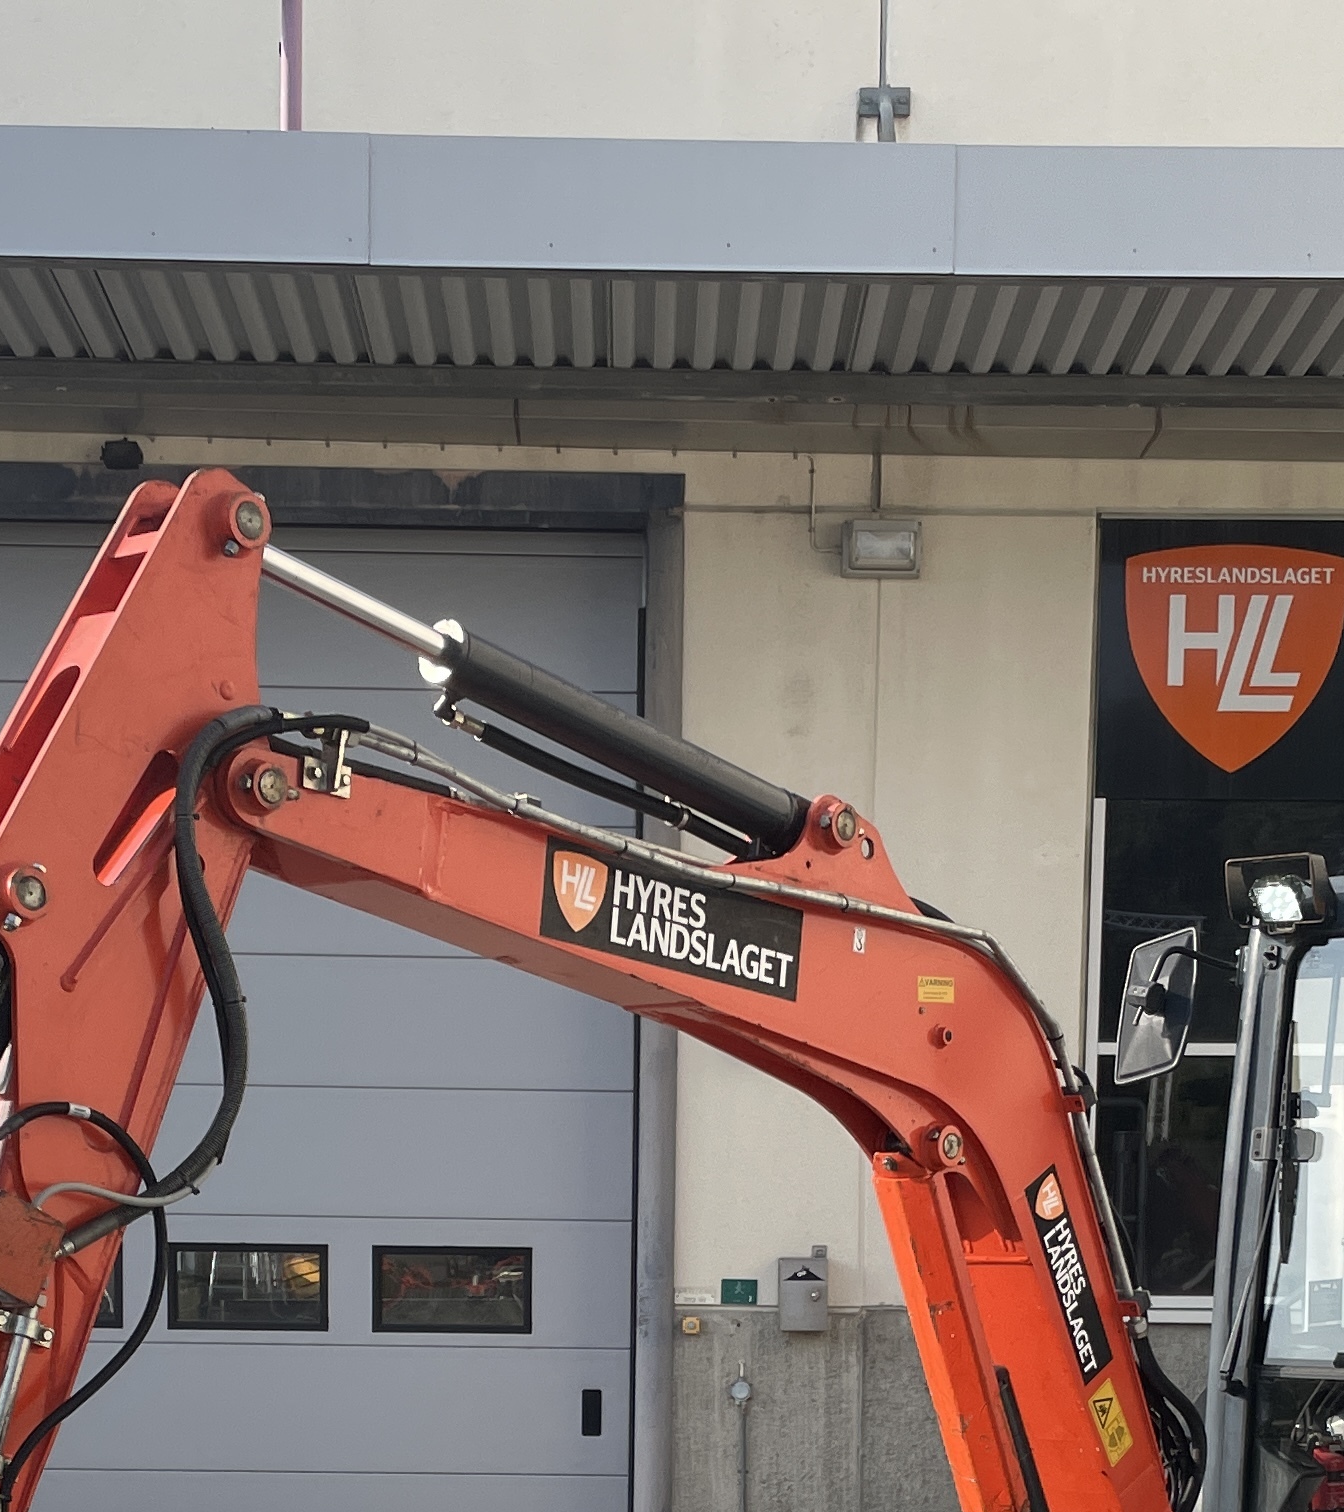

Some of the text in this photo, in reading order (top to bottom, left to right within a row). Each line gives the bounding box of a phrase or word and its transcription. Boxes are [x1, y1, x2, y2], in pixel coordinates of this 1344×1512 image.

[1142, 567, 1334, 585] HYRESLANDSLAGET
[1167, 594, 1301, 712] HLL
[560, 859, 598, 912] HLL
[612, 869, 707, 929] HYRES
[609, 907, 794, 988] LANDSLAGET
[1055, 1218, 1086, 1295] HYRES
[1043, 1228, 1098, 1374] LANDSLAGET
